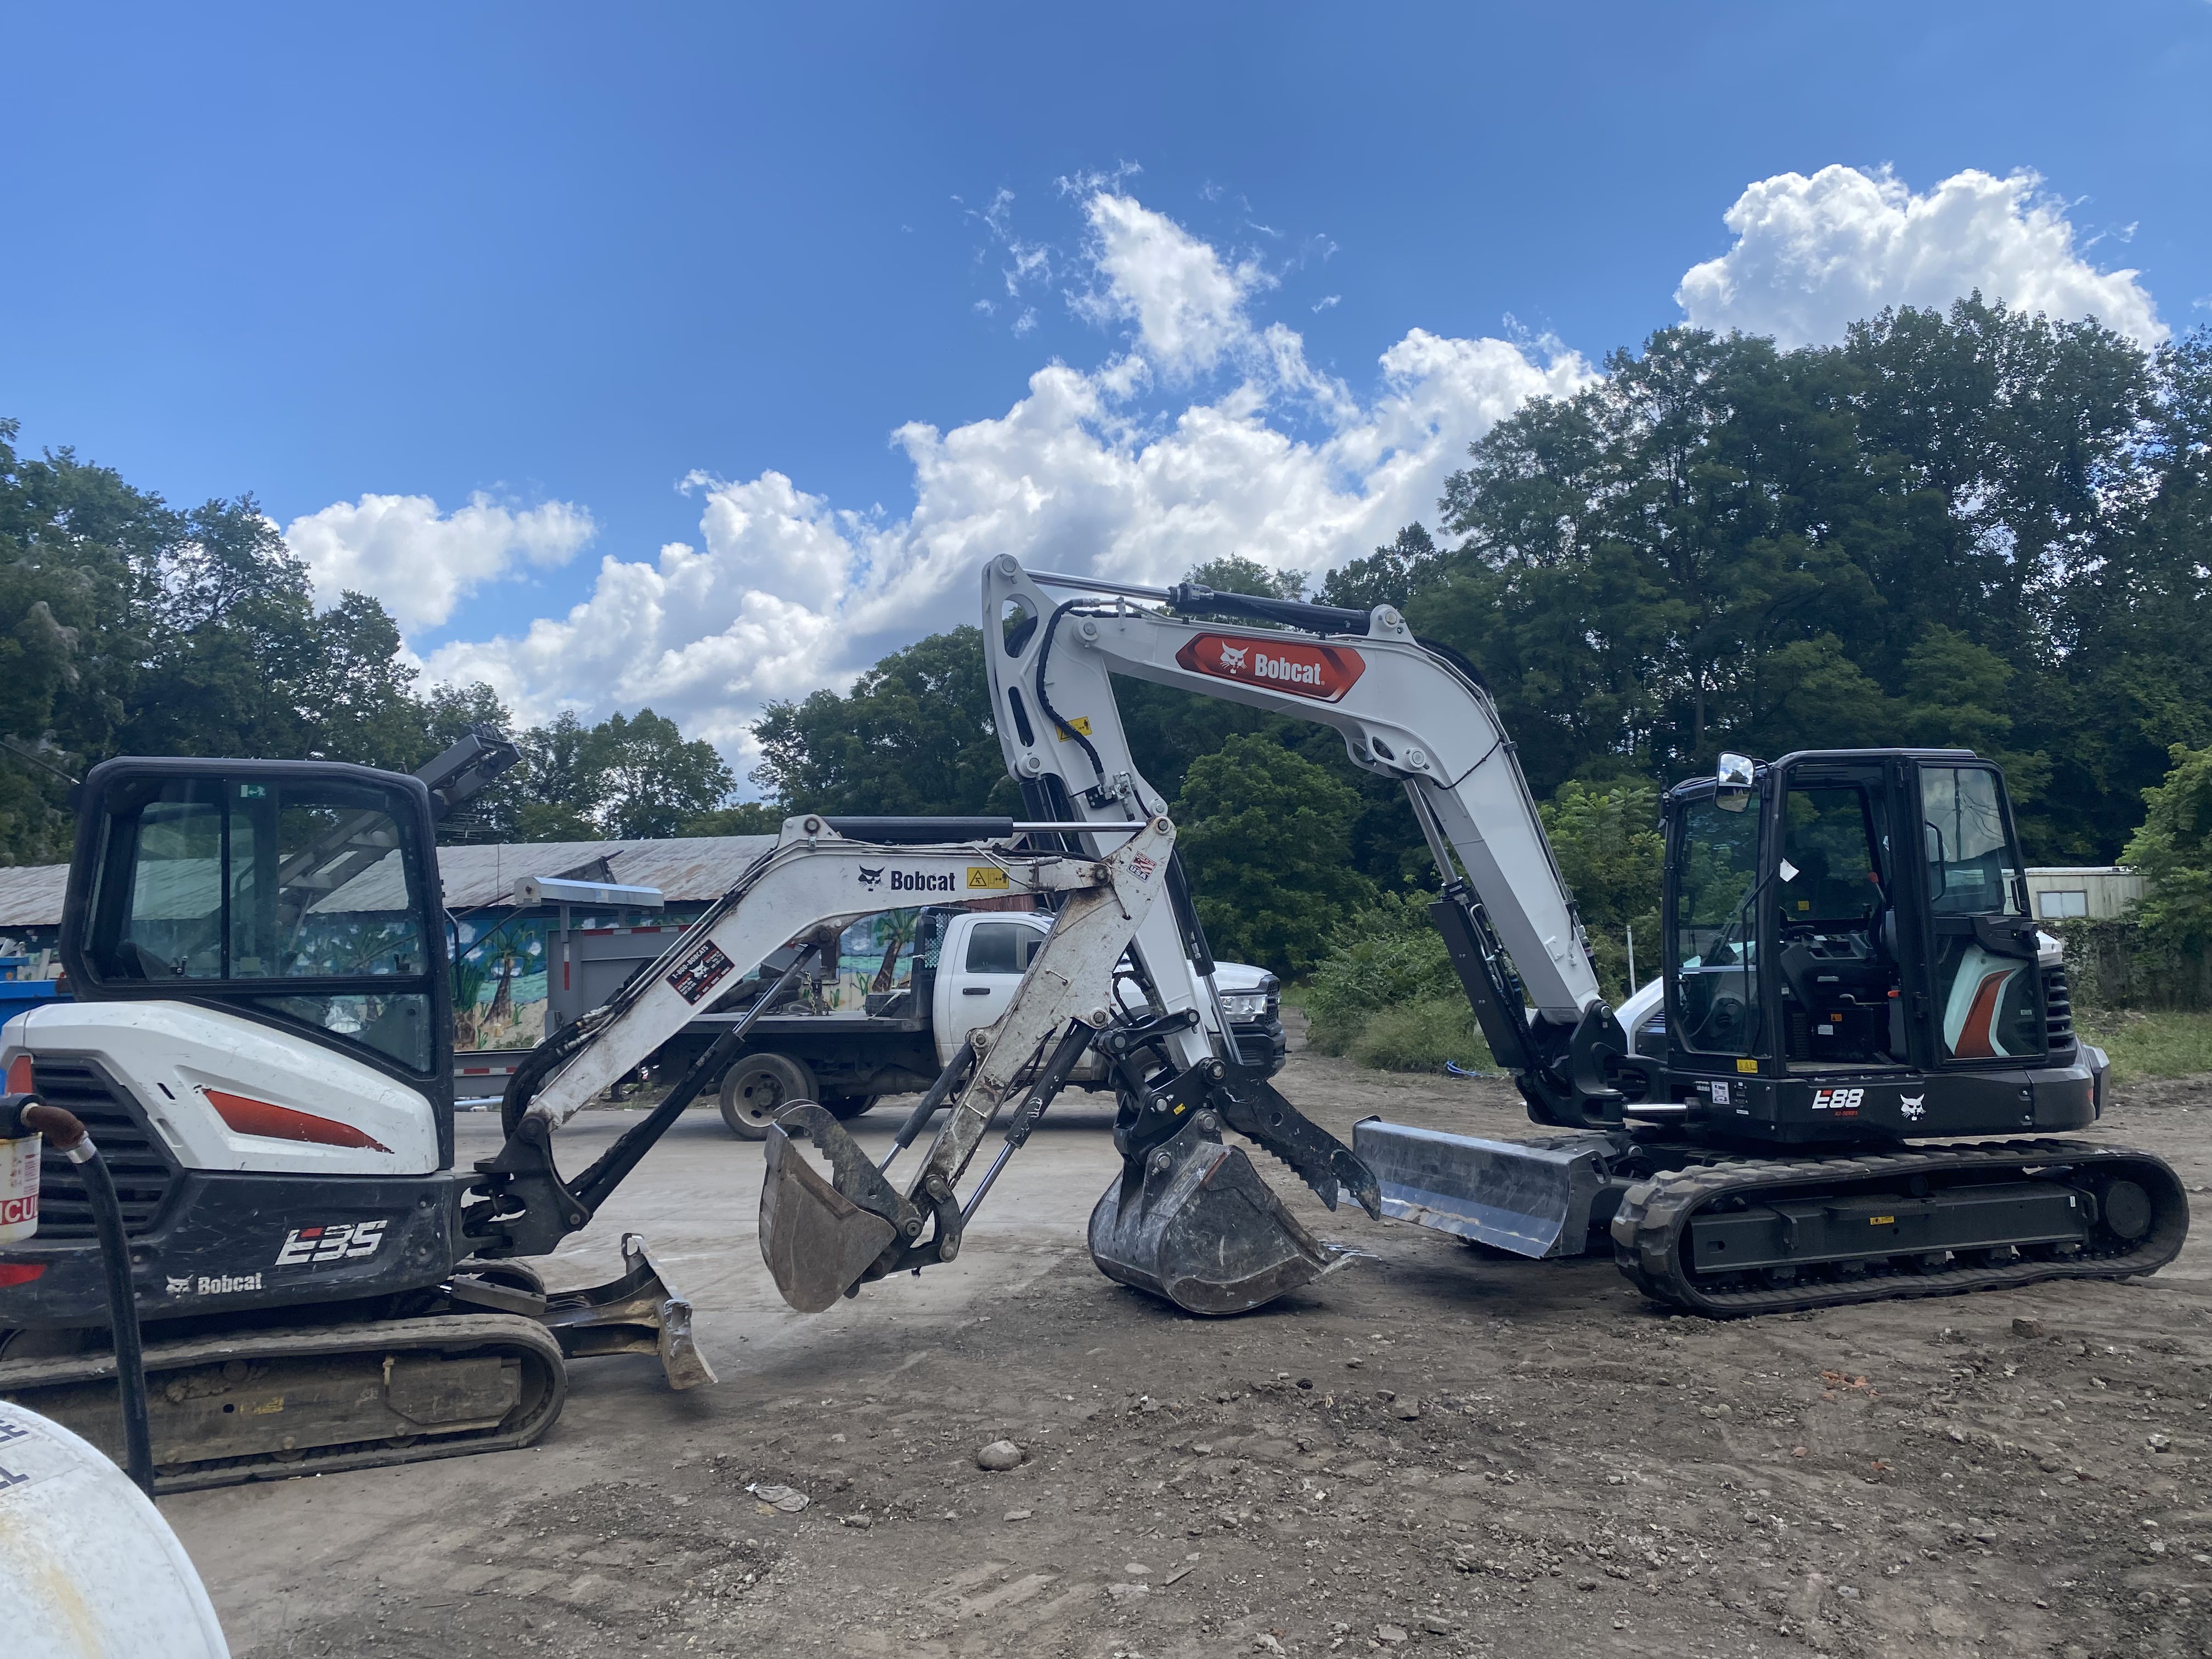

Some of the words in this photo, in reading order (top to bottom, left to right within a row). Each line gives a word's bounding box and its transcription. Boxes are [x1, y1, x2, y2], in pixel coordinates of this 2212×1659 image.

[1255, 653, 1321, 685] Bobcat
[891, 871, 955, 891] Bobcat
[1129, 865, 1147, 880] USA
[672, 945, 709, 979] 1-800-BOBCATS
[1812, 1088, 1864, 1109] E88
[275, 1220, 387, 1266] E35
[198, 1272, 262, 1295] Bobcat
